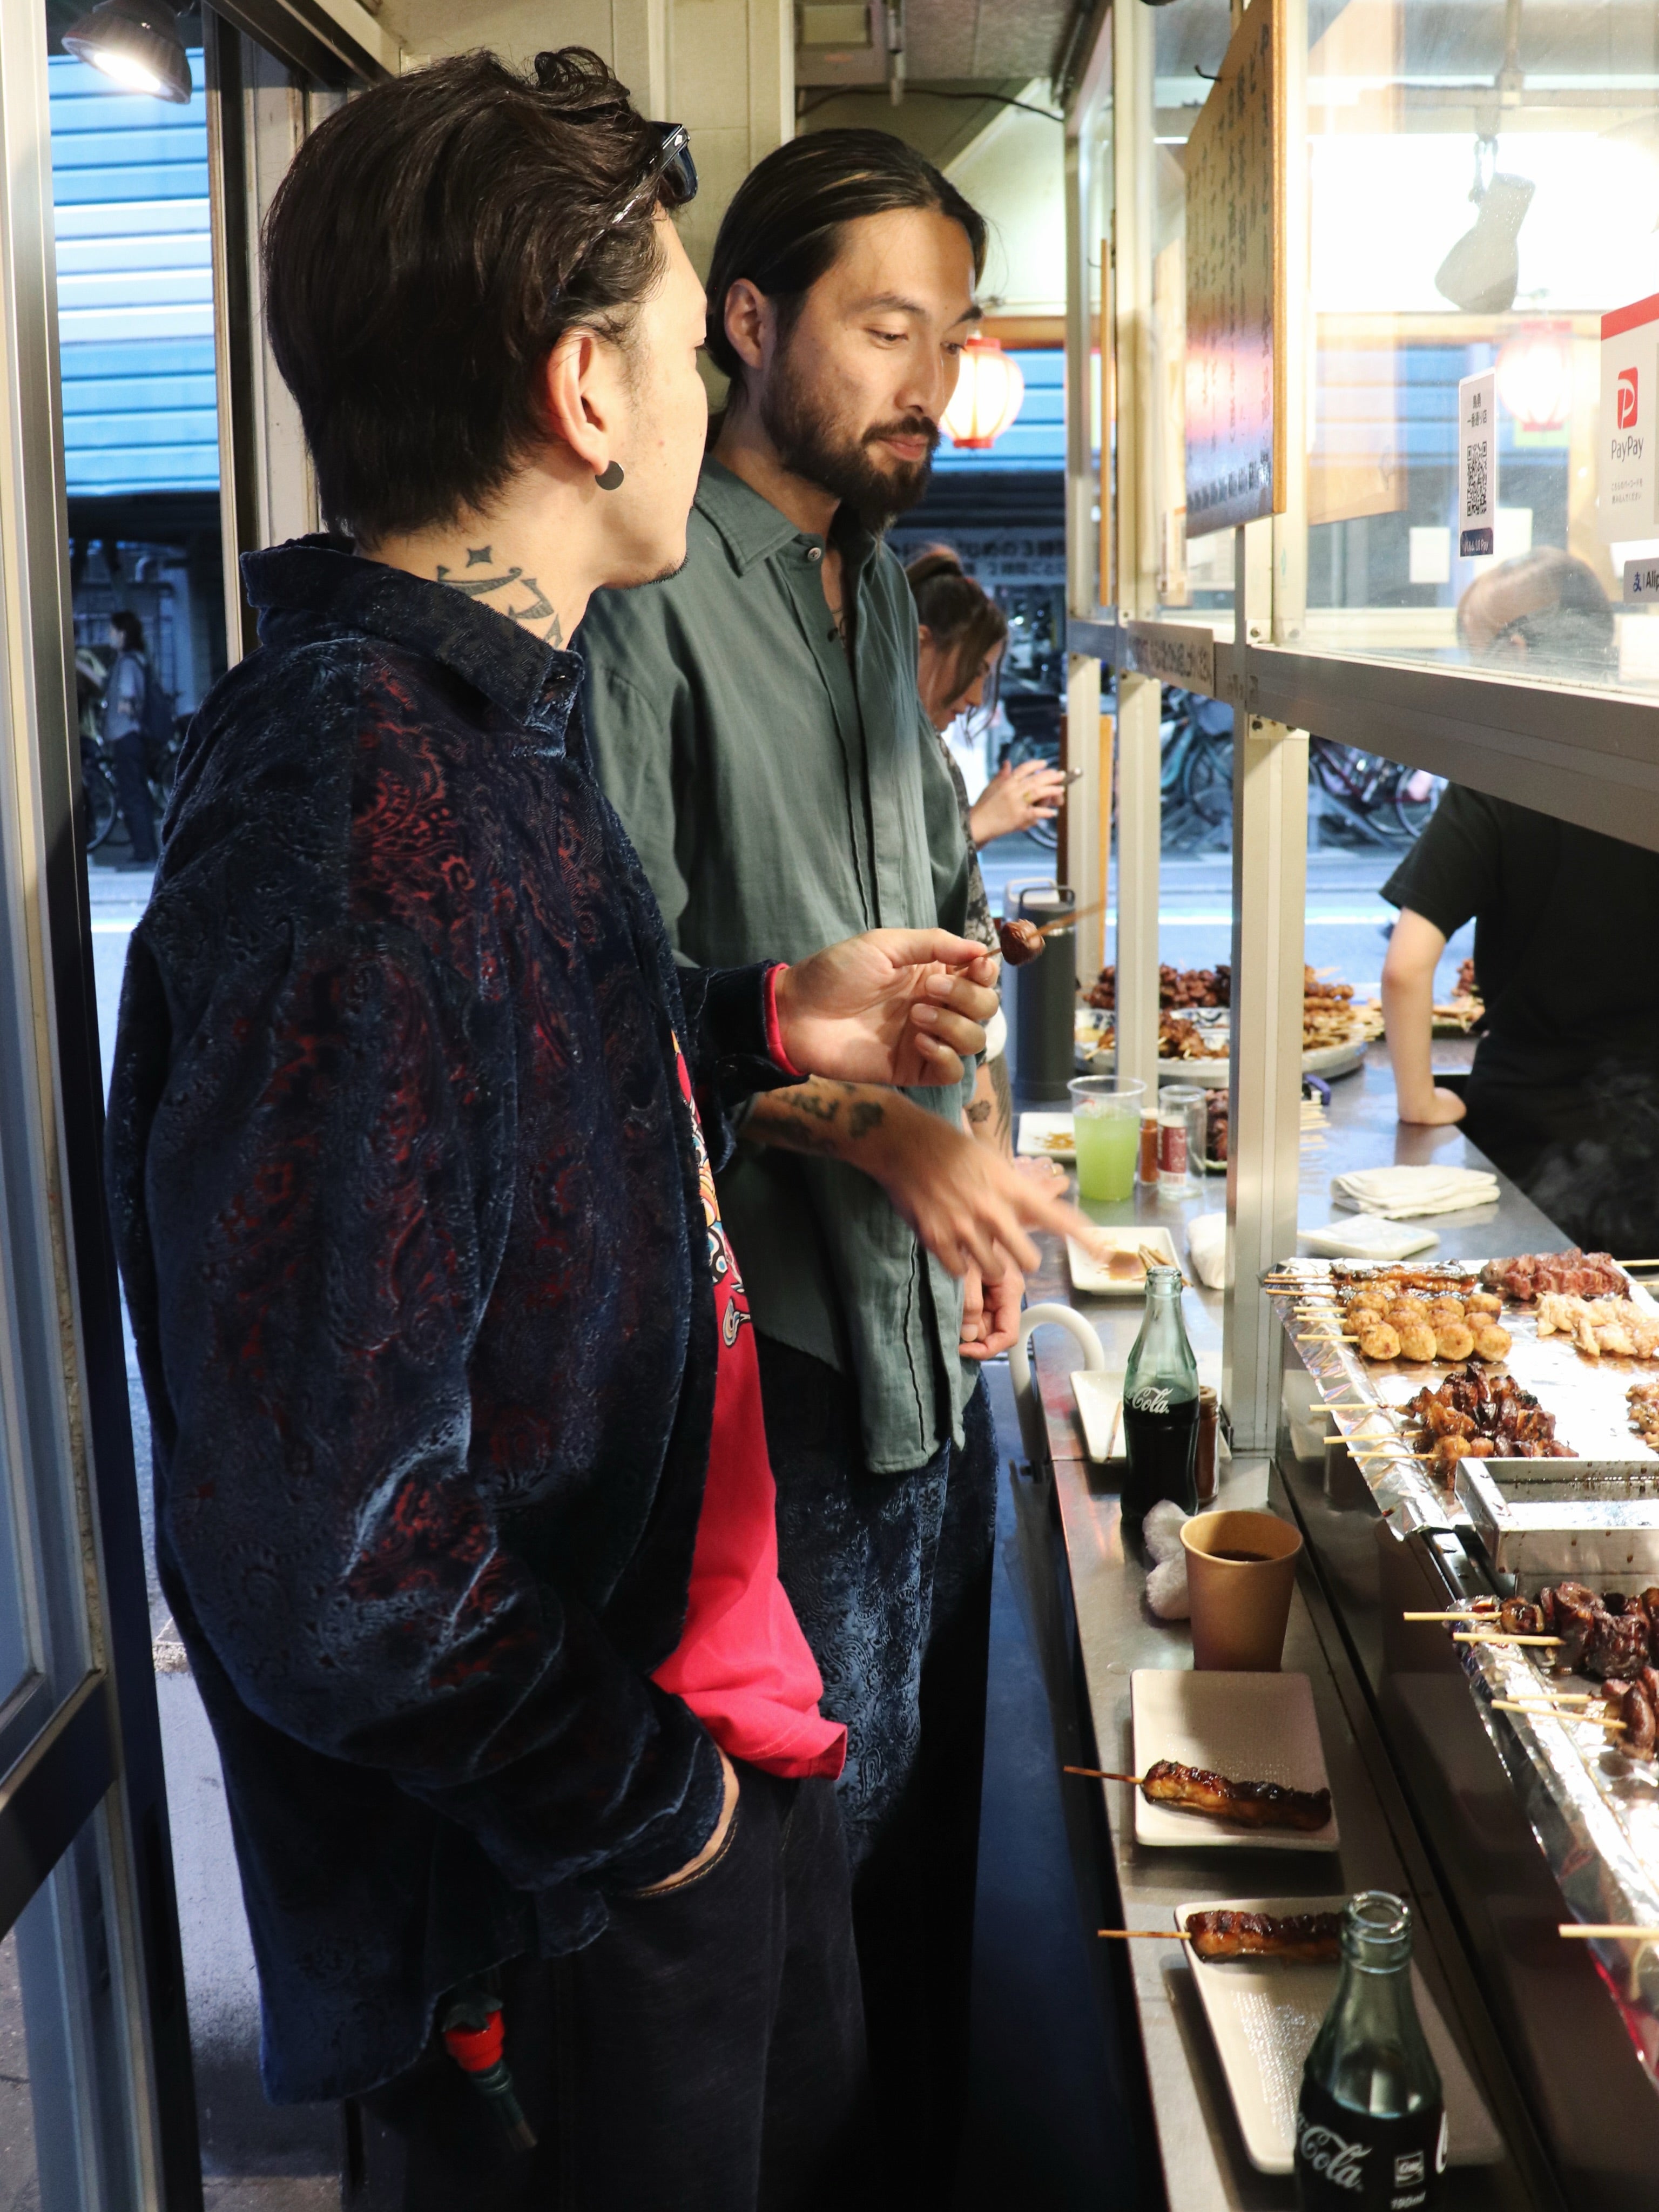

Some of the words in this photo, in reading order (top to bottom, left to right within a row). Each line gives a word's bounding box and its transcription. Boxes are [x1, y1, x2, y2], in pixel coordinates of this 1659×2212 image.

[1611, 435, 1644, 462] PayPay
[1132, 1386, 1173, 1413] Cola
[1300, 2126, 1373, 2187] Cola
